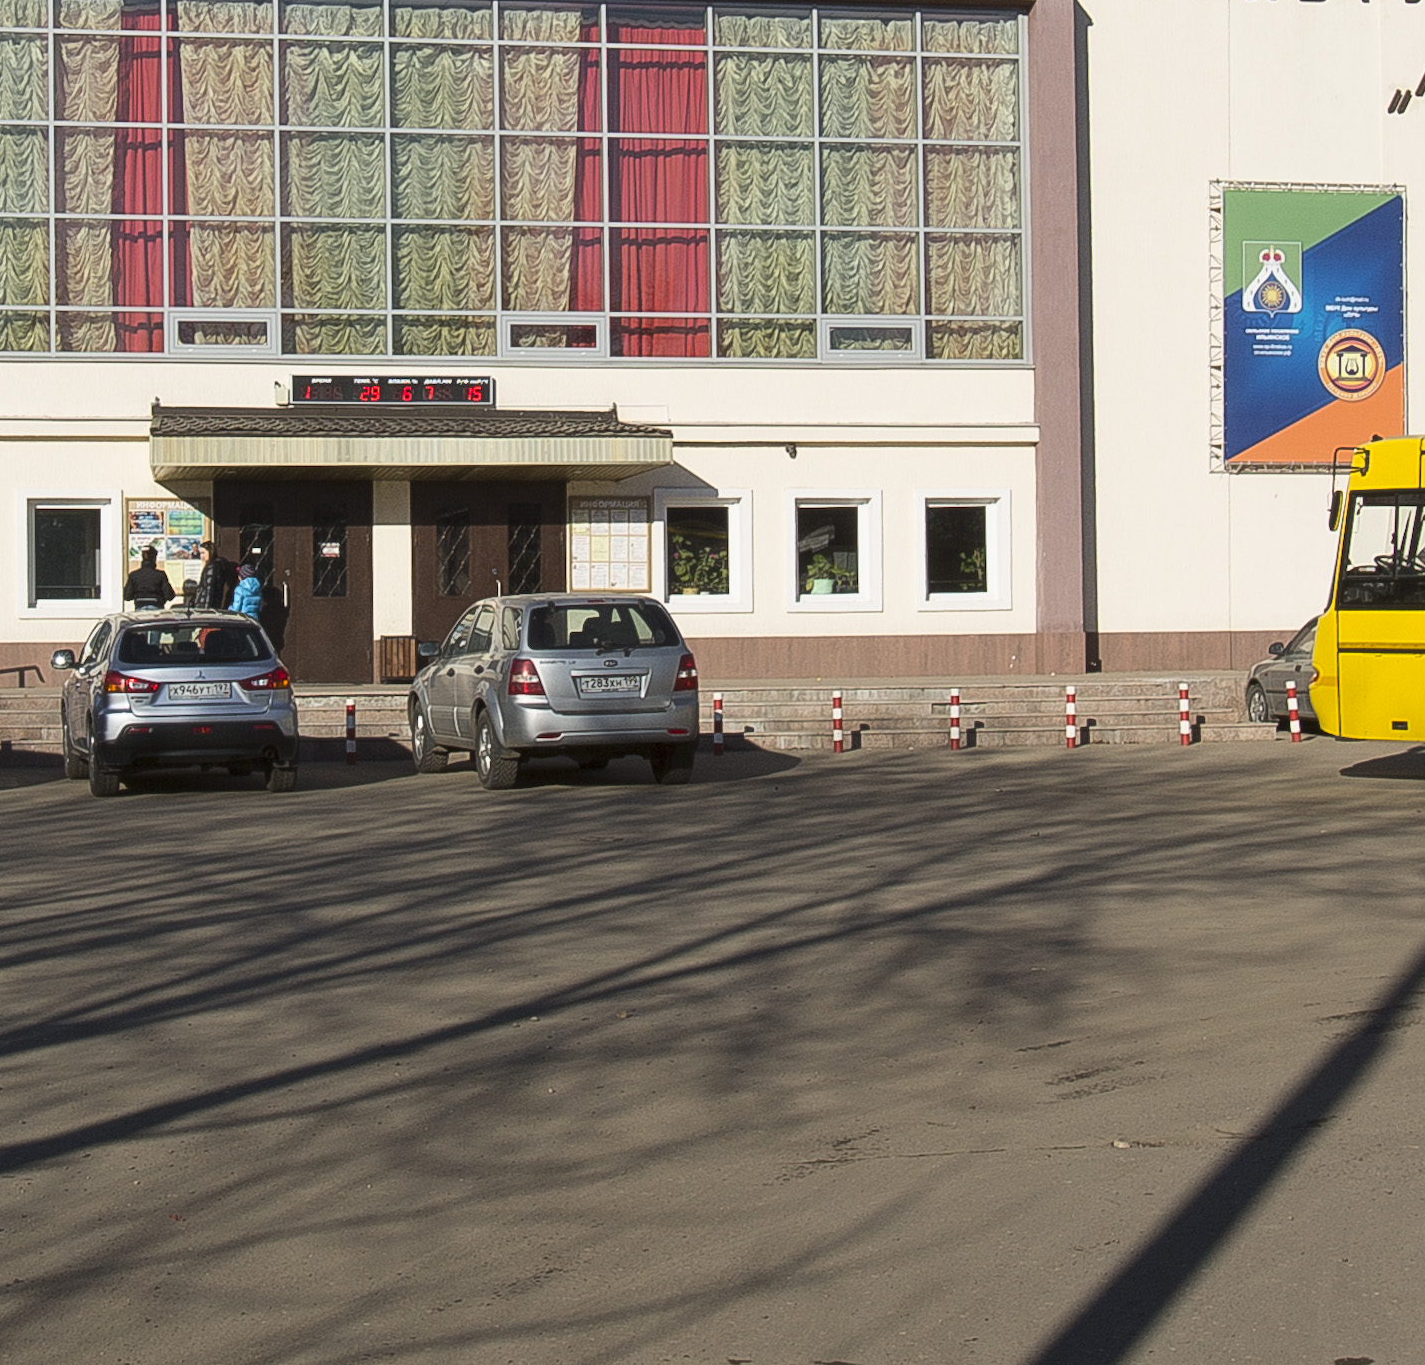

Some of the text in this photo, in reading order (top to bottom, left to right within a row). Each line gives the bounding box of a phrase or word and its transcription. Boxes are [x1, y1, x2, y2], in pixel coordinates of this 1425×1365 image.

[359, 386, 380, 402] 29
[467, 386, 482, 402] 15
[135, 501, 200, 509] ИНФОРМАЦИЯ
[579, 500, 640, 509] ИНФОРМАЦИЯ
